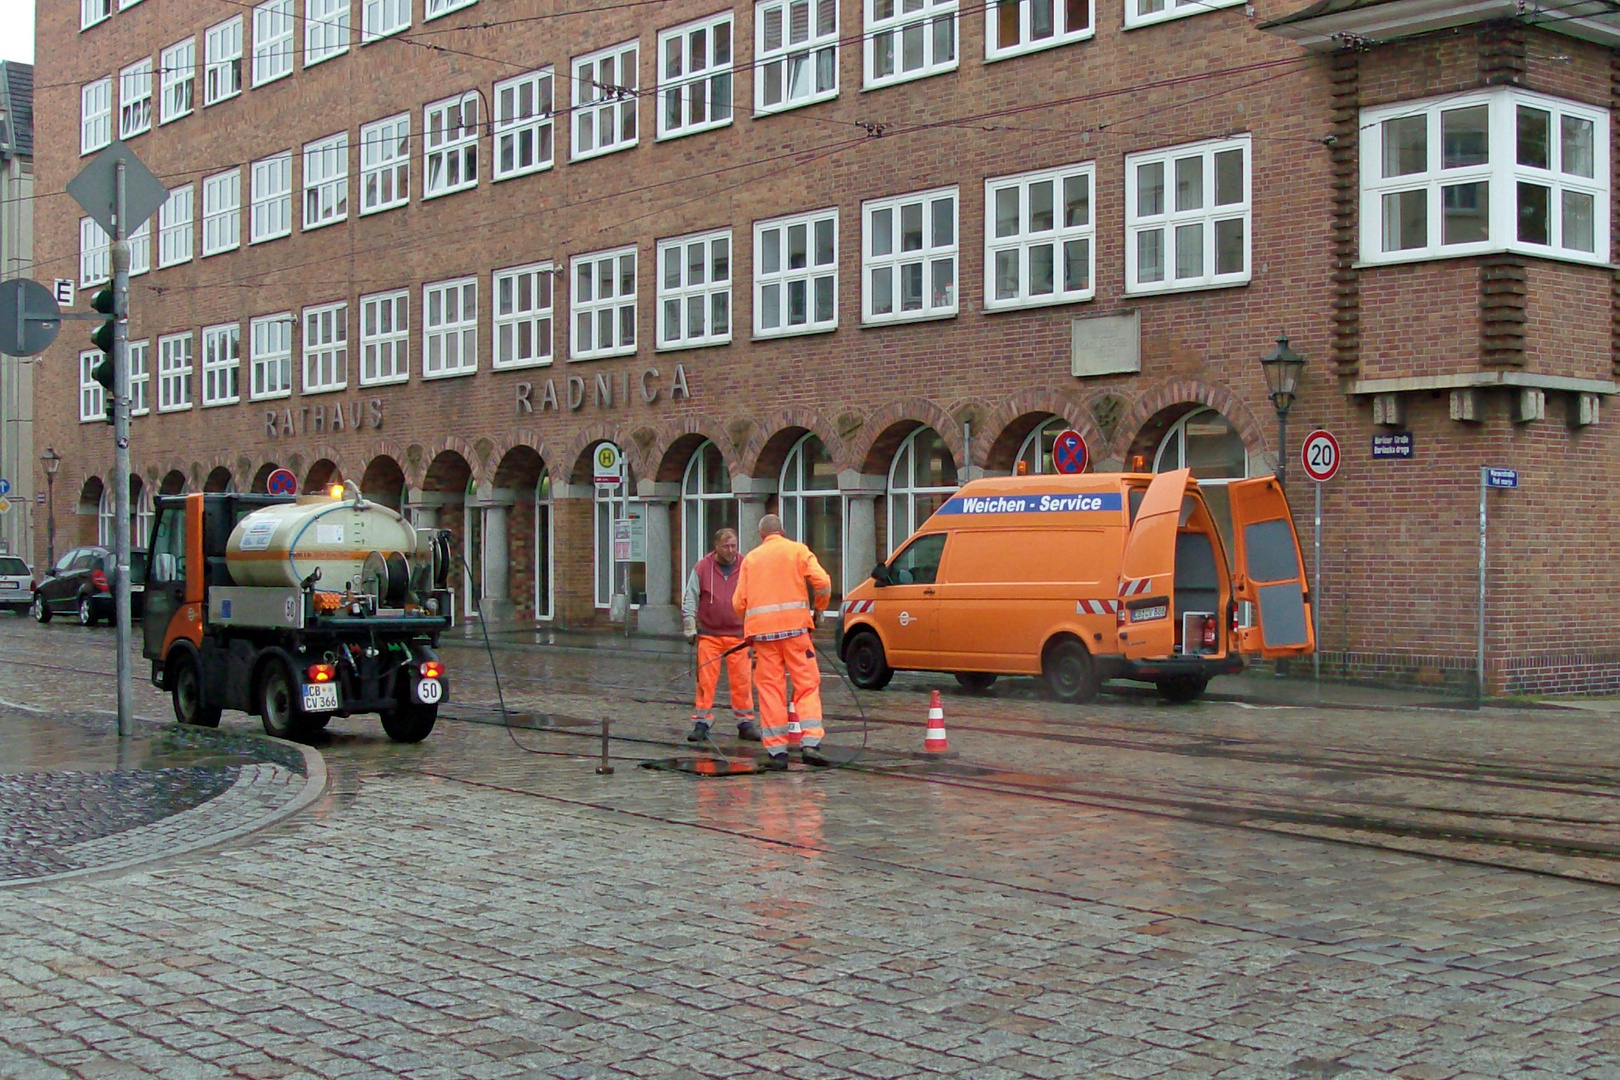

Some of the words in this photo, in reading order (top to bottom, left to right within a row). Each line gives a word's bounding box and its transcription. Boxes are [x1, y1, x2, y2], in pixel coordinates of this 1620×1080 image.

[57, 282, 71, 303] E
[515, 363, 690, 413] RADNICA
[266, 397, 382, 436] RATHAUS
[603, 453, 611, 464] H
[1311, 444, 1332, 466] 20
[962, 497, 1026, 513] Weichen
[1039, 495, 1102, 512] Service
[308, 685, 321, 697] CB
[422, 682, 437, 698] 50
[305, 697, 318, 709] CV
[320, 695, 337, 708] 366
